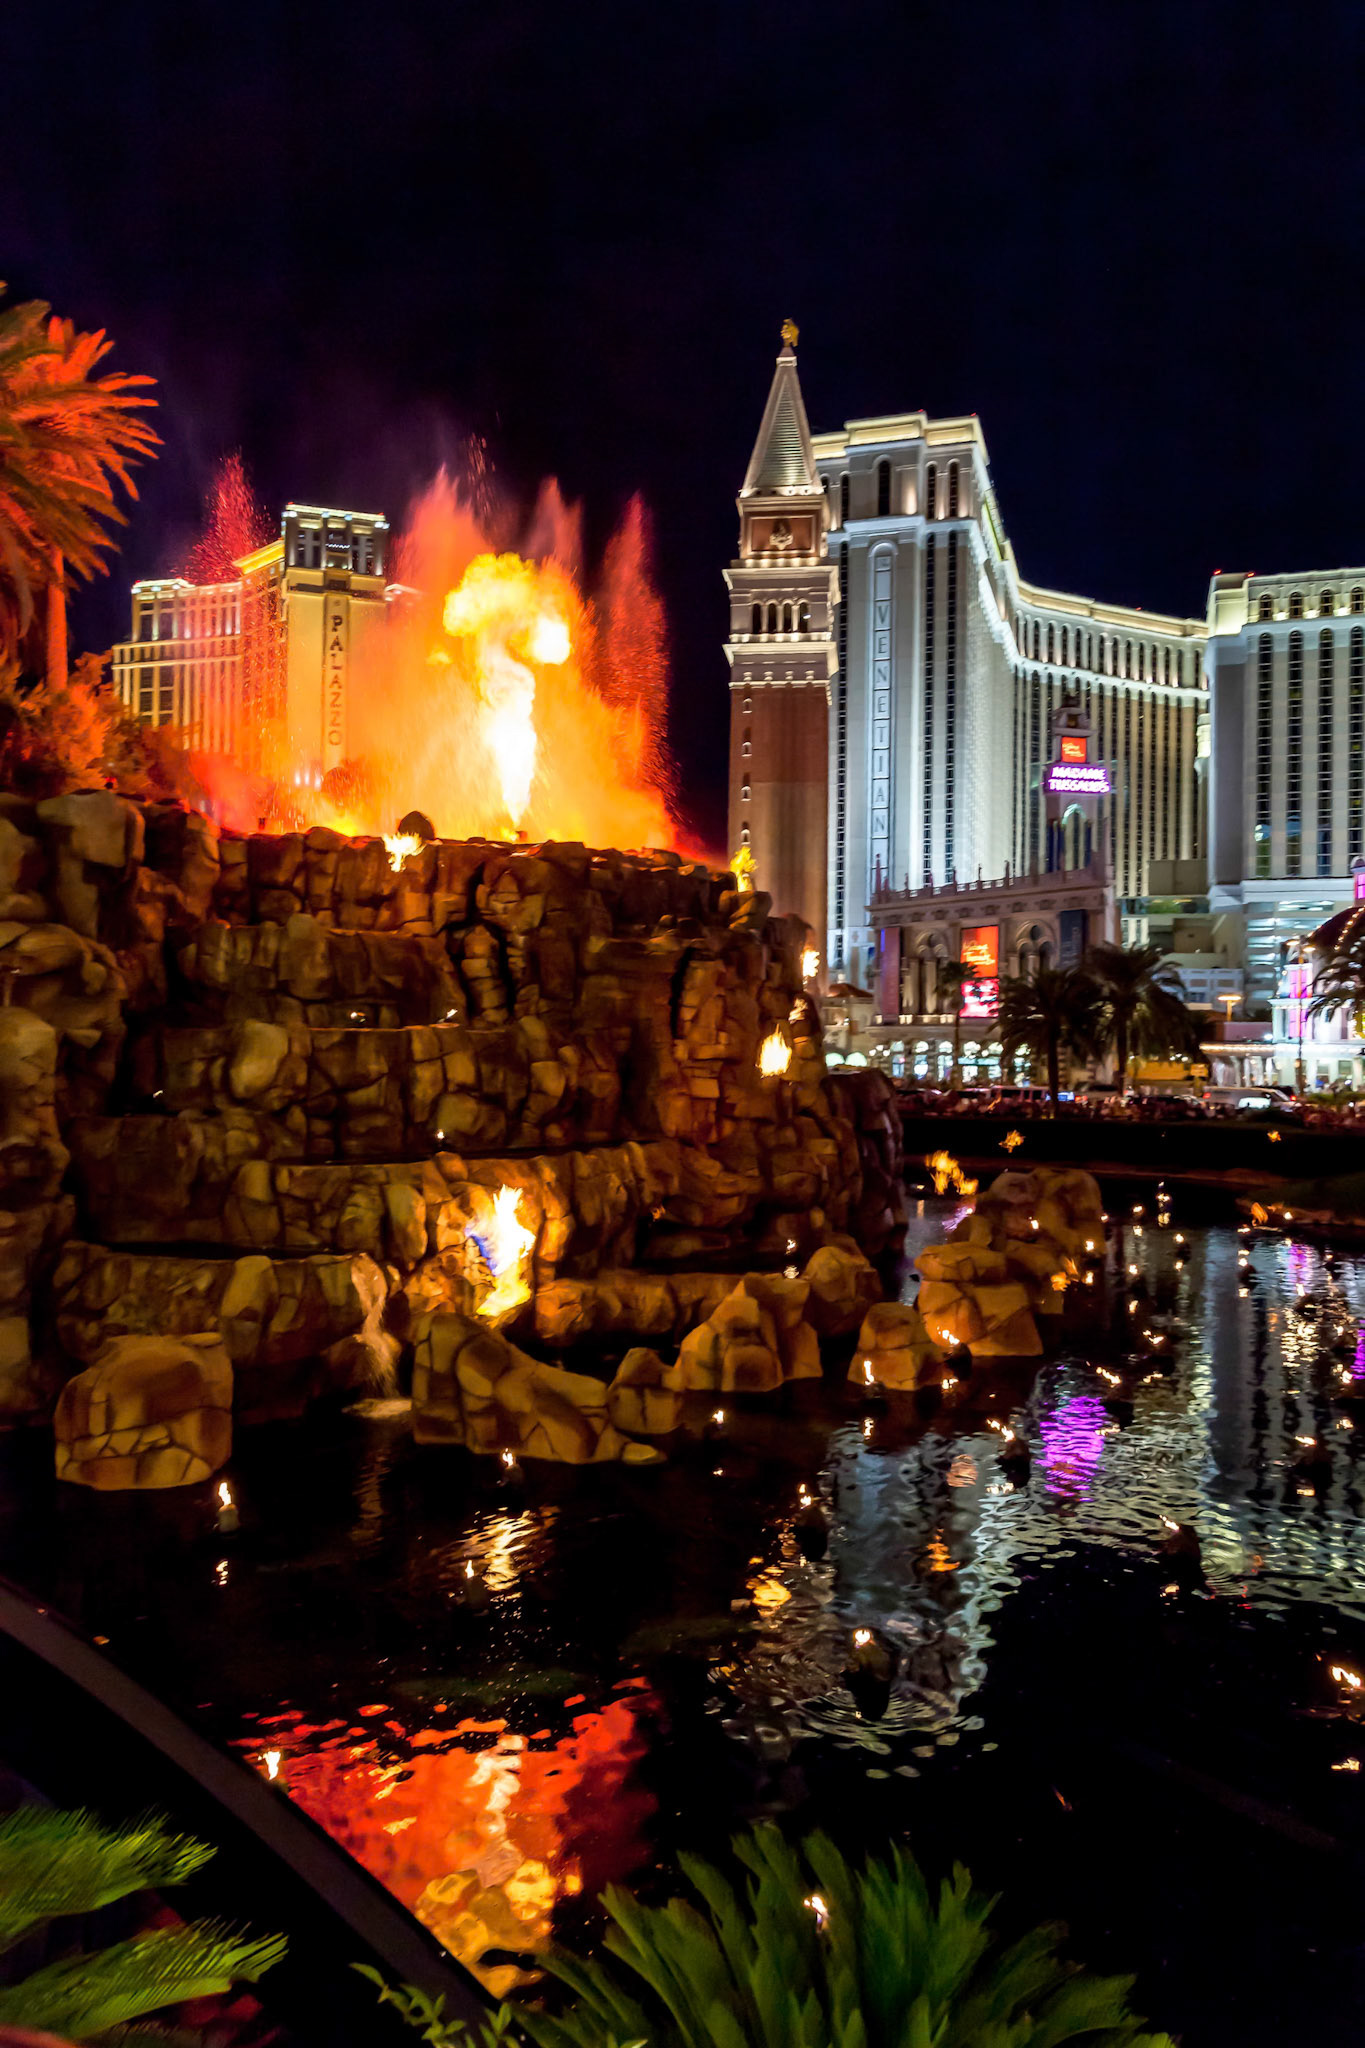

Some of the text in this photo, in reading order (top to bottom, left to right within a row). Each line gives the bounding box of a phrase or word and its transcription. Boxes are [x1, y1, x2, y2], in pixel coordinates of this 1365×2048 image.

[328, 615, 343, 746] PALAZZO
[876, 605, 889, 833] VENETIAN
[1052, 766, 1106, 780] MADAME
